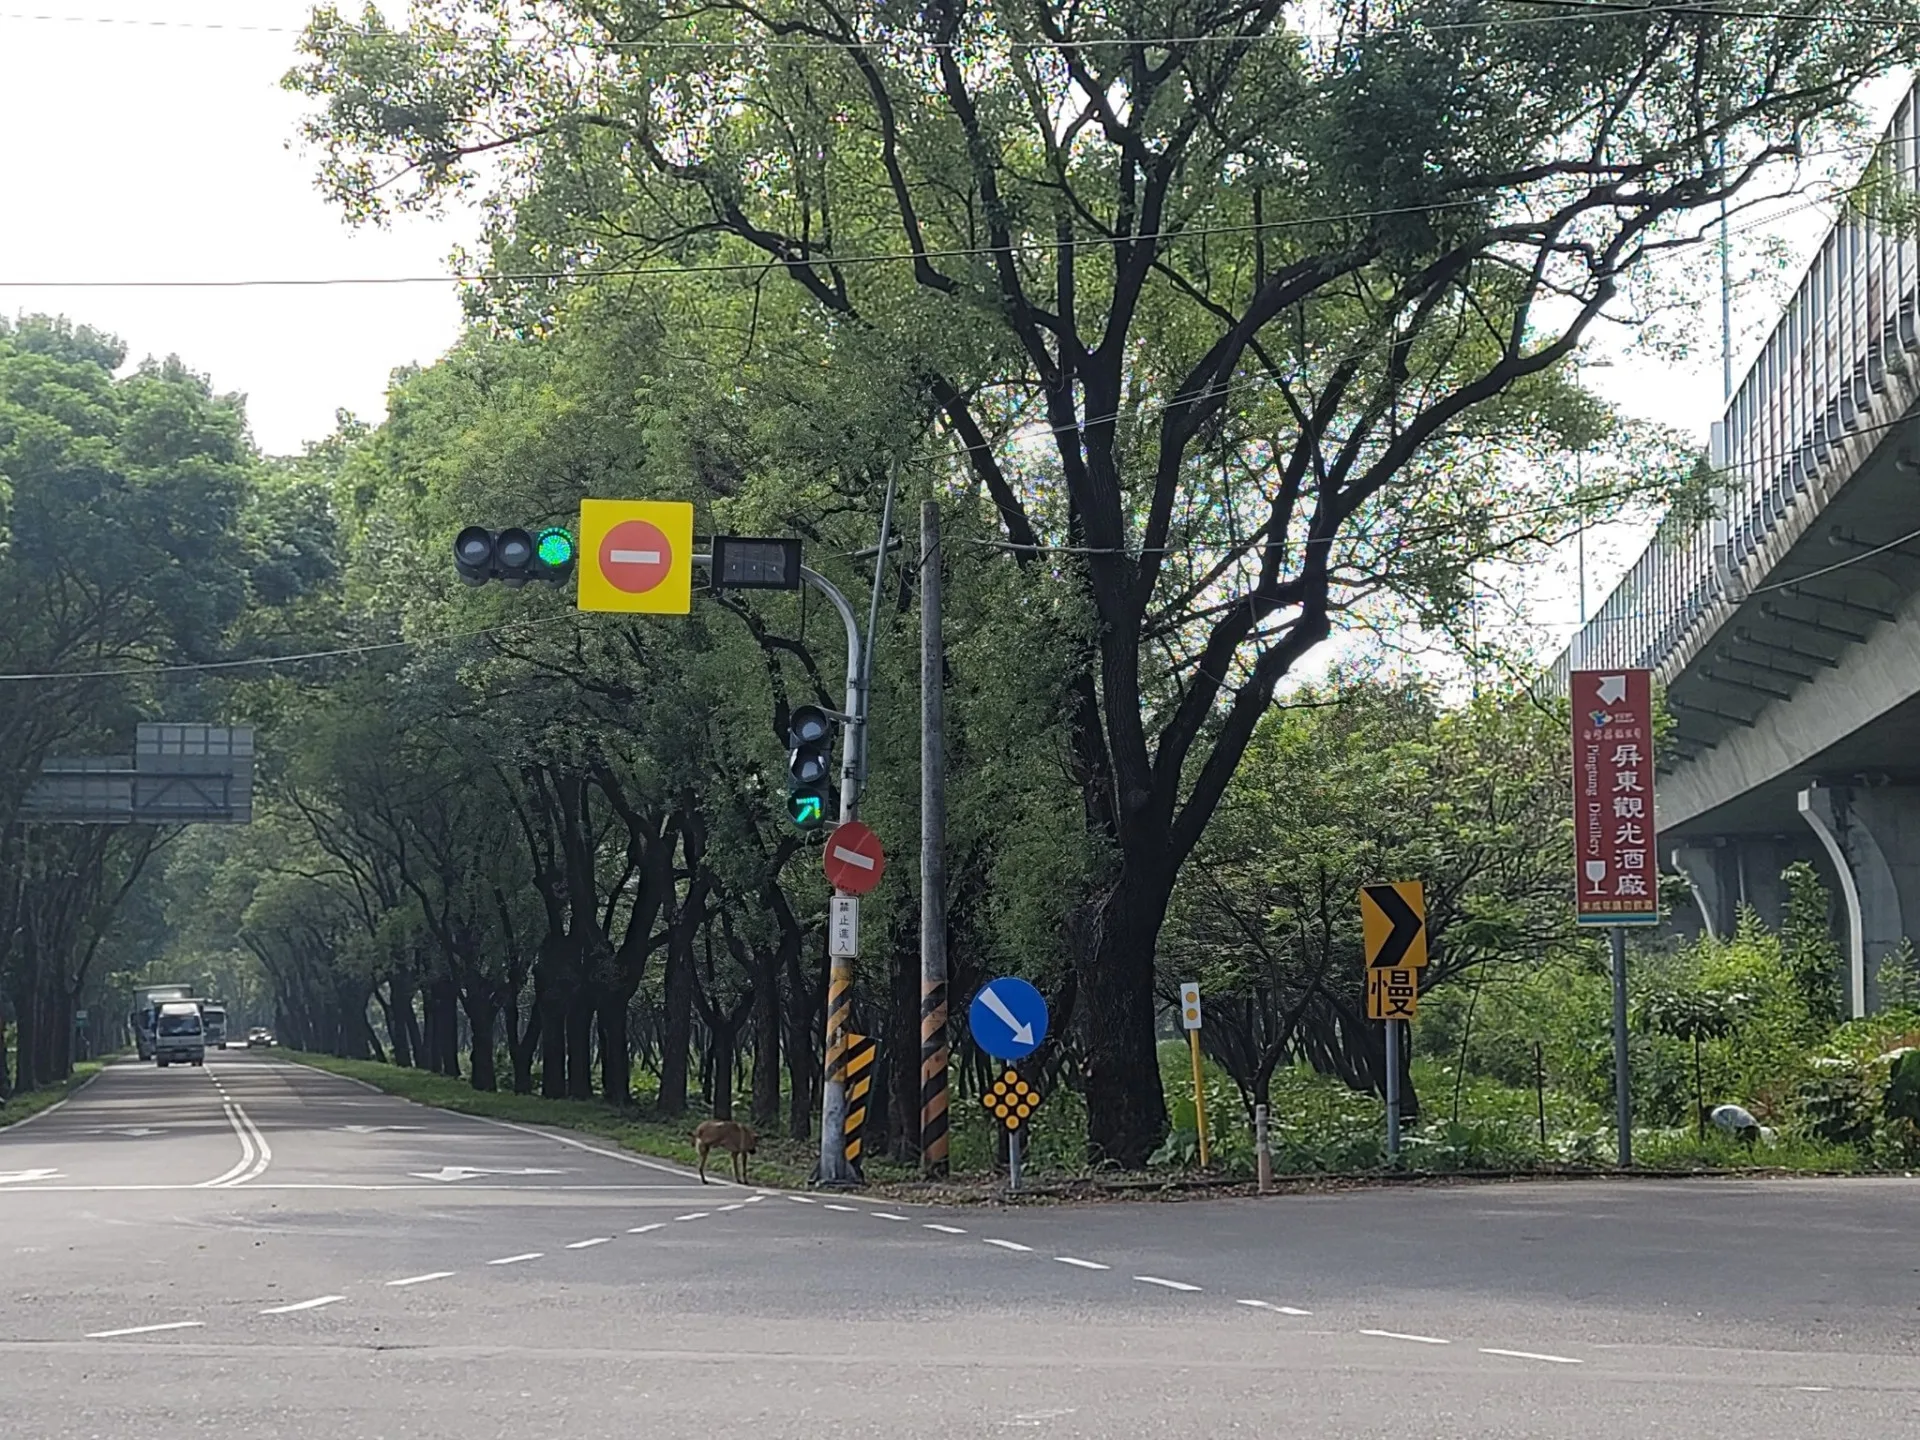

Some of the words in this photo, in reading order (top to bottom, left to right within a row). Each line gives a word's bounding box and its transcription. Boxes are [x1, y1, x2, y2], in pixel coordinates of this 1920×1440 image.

[1585, 744, 1600, 796] Pingtung
[1587, 803, 1602, 857] Distillery
[1611, 744, 1648, 895] 屏東觀光酒廠
[838, 902, 850, 952] 禁止進入
[1370, 970, 1415, 1017] 慢
